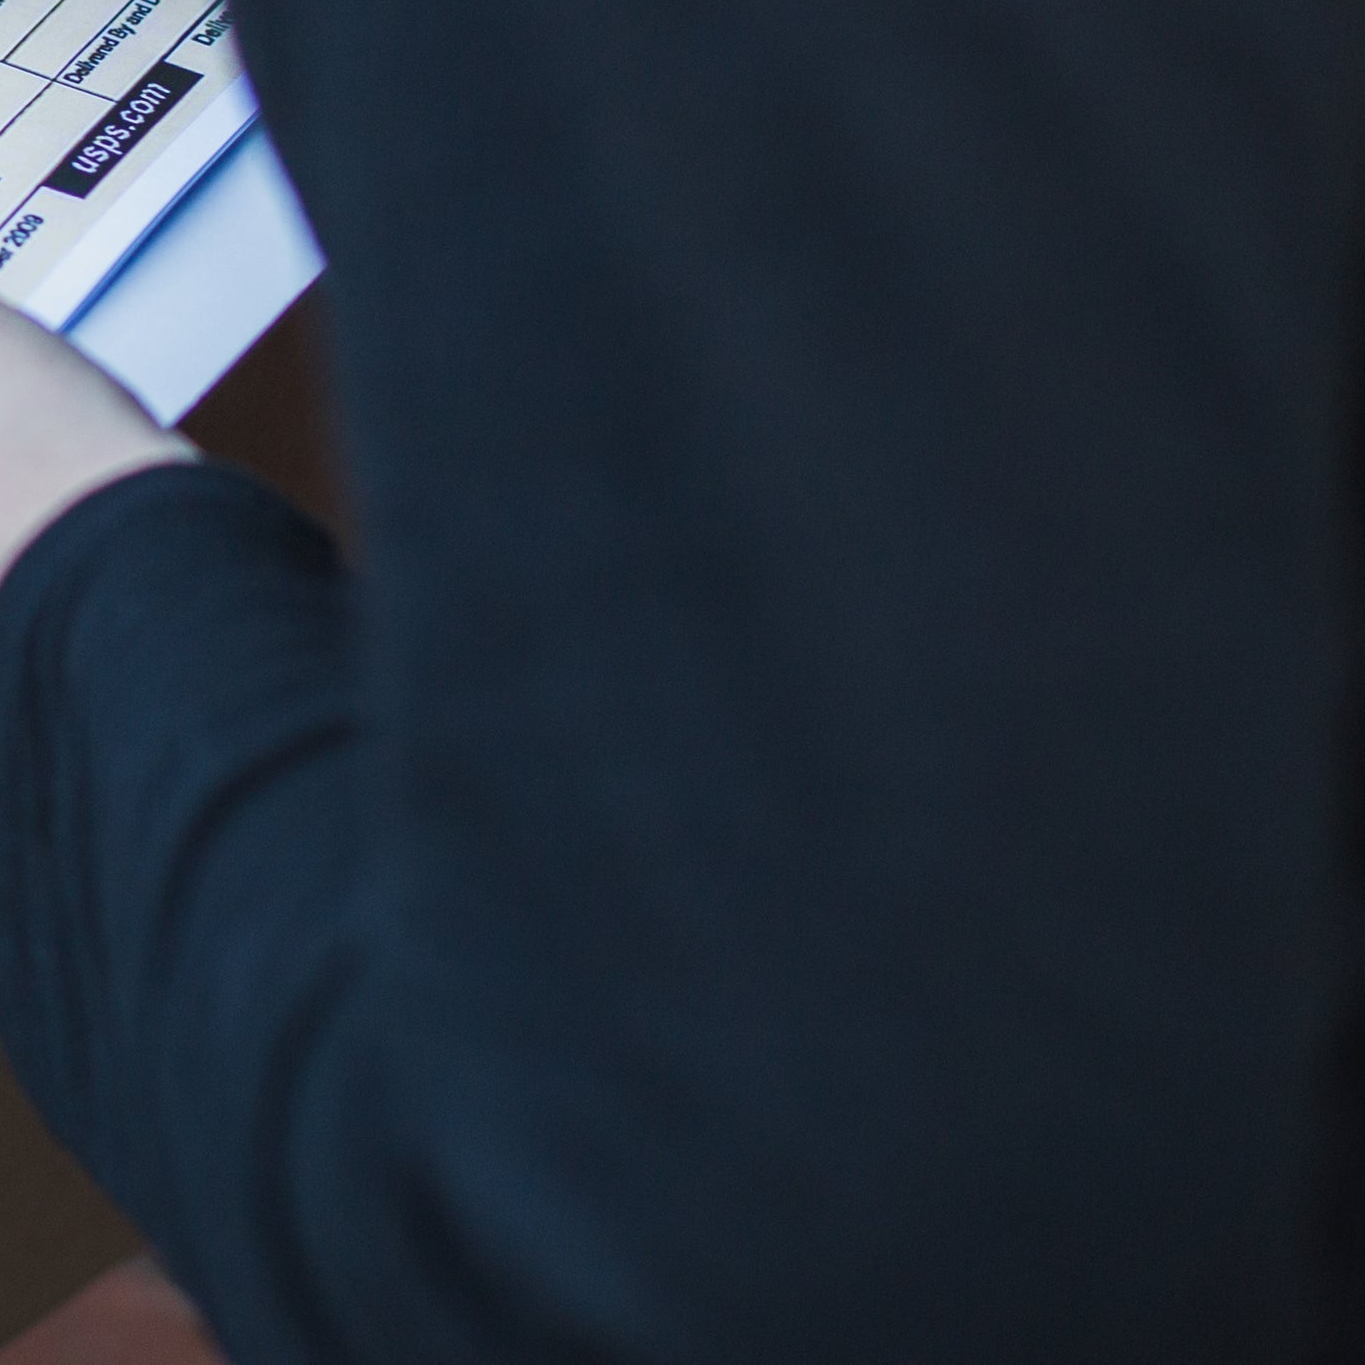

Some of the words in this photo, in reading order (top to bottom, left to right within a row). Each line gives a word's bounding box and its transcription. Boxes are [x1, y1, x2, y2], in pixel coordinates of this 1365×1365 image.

[62, 36, 120, 84] Delivered
[108, 23, 134, 39] By
[124, 3, 153, 26] and
[70, 80, 172, 175] usps.com
